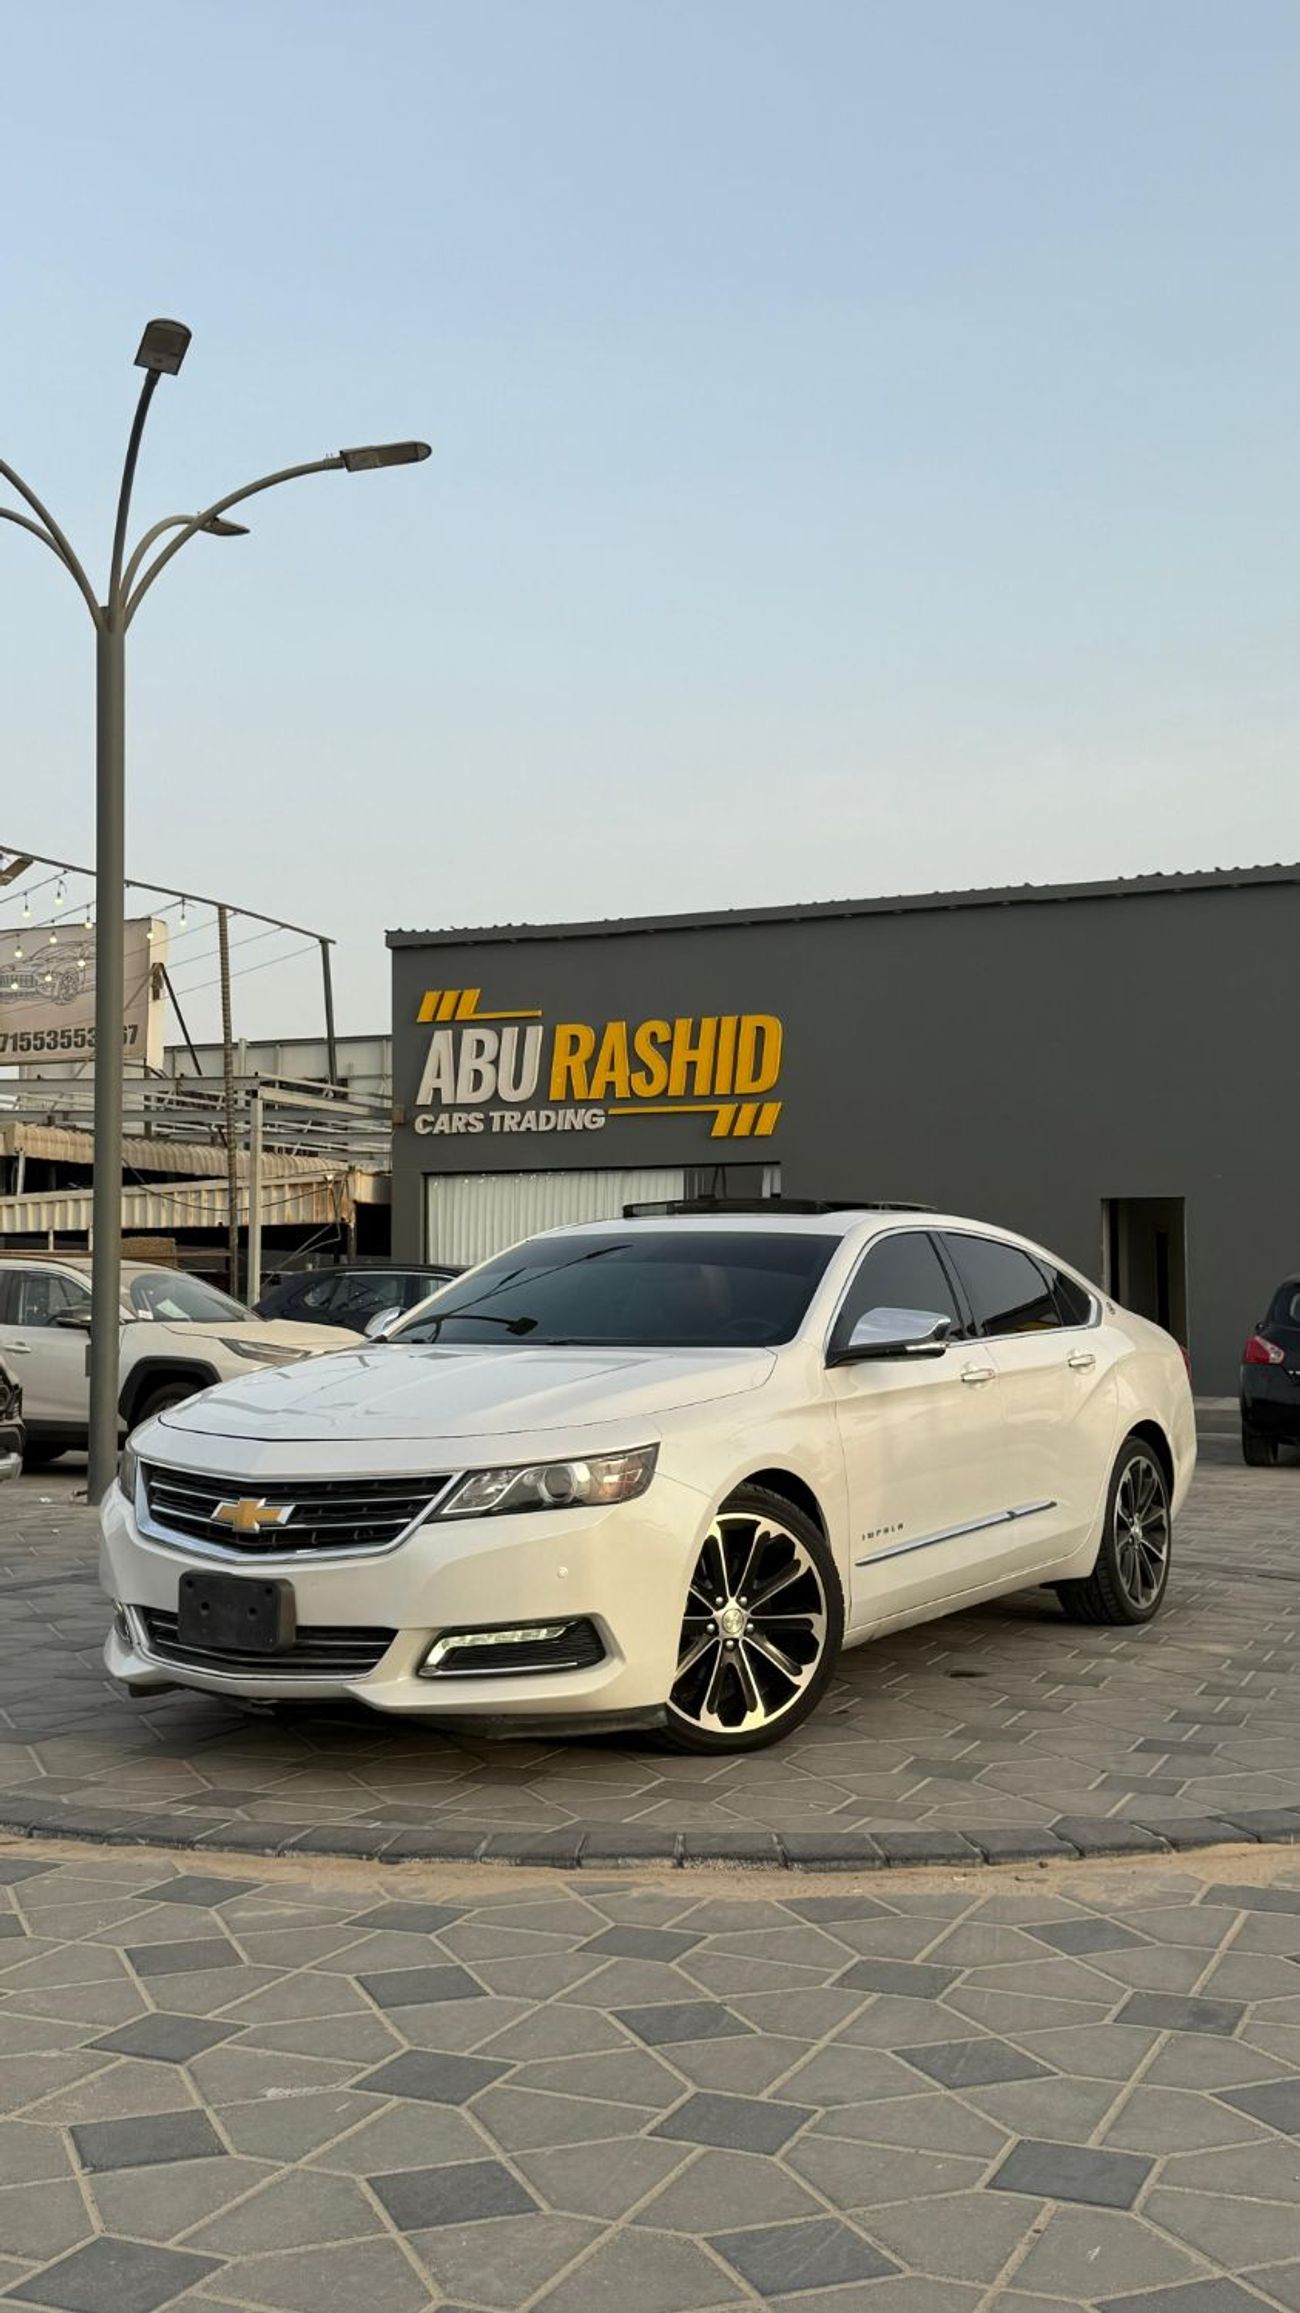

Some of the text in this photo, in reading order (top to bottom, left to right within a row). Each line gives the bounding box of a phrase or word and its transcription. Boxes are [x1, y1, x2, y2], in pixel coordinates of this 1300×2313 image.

[415, 1014, 783, 1106] ABU RASHID
[414, 1108, 606, 1135] CARS TRADING
